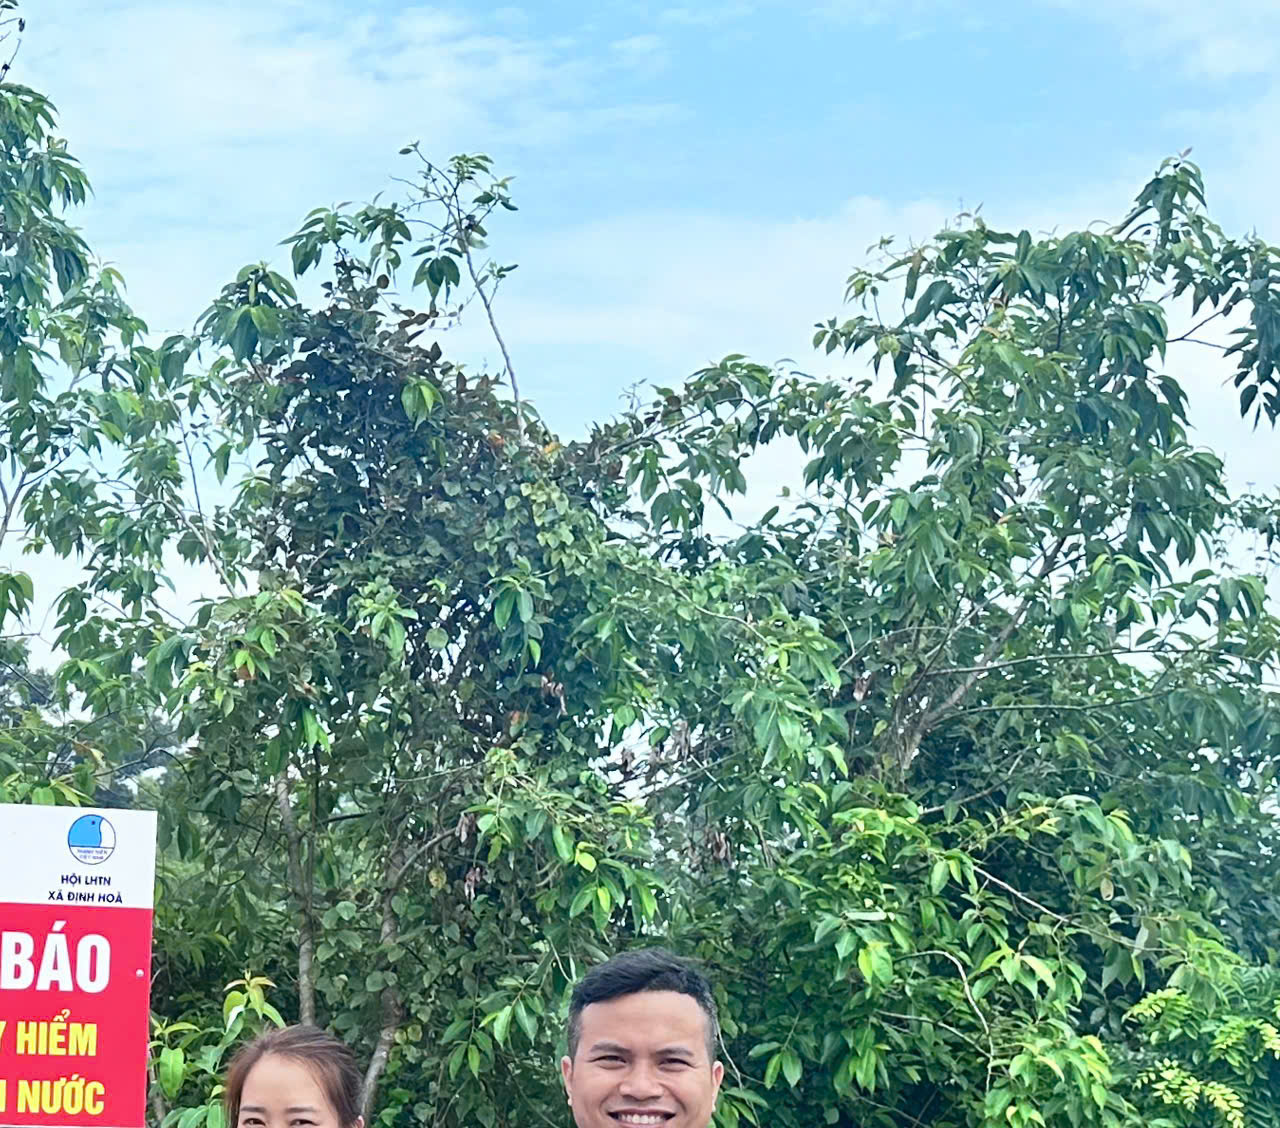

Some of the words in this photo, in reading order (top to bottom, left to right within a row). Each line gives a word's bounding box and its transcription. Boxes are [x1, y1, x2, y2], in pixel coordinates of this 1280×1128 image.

[48, 889, 64, 901] XÃ
[67, 891, 95, 903] ĐỊNH
[98, 891, 123, 904] HOÀ
[61, 873, 81, 887] HỘI
[85, 876, 111, 886] LHTN
[0, 920, 112, 993] BÁO
[16, 1009, 97, 1056] HIỂM
[17, 1074, 105, 1115] NƯỚC
